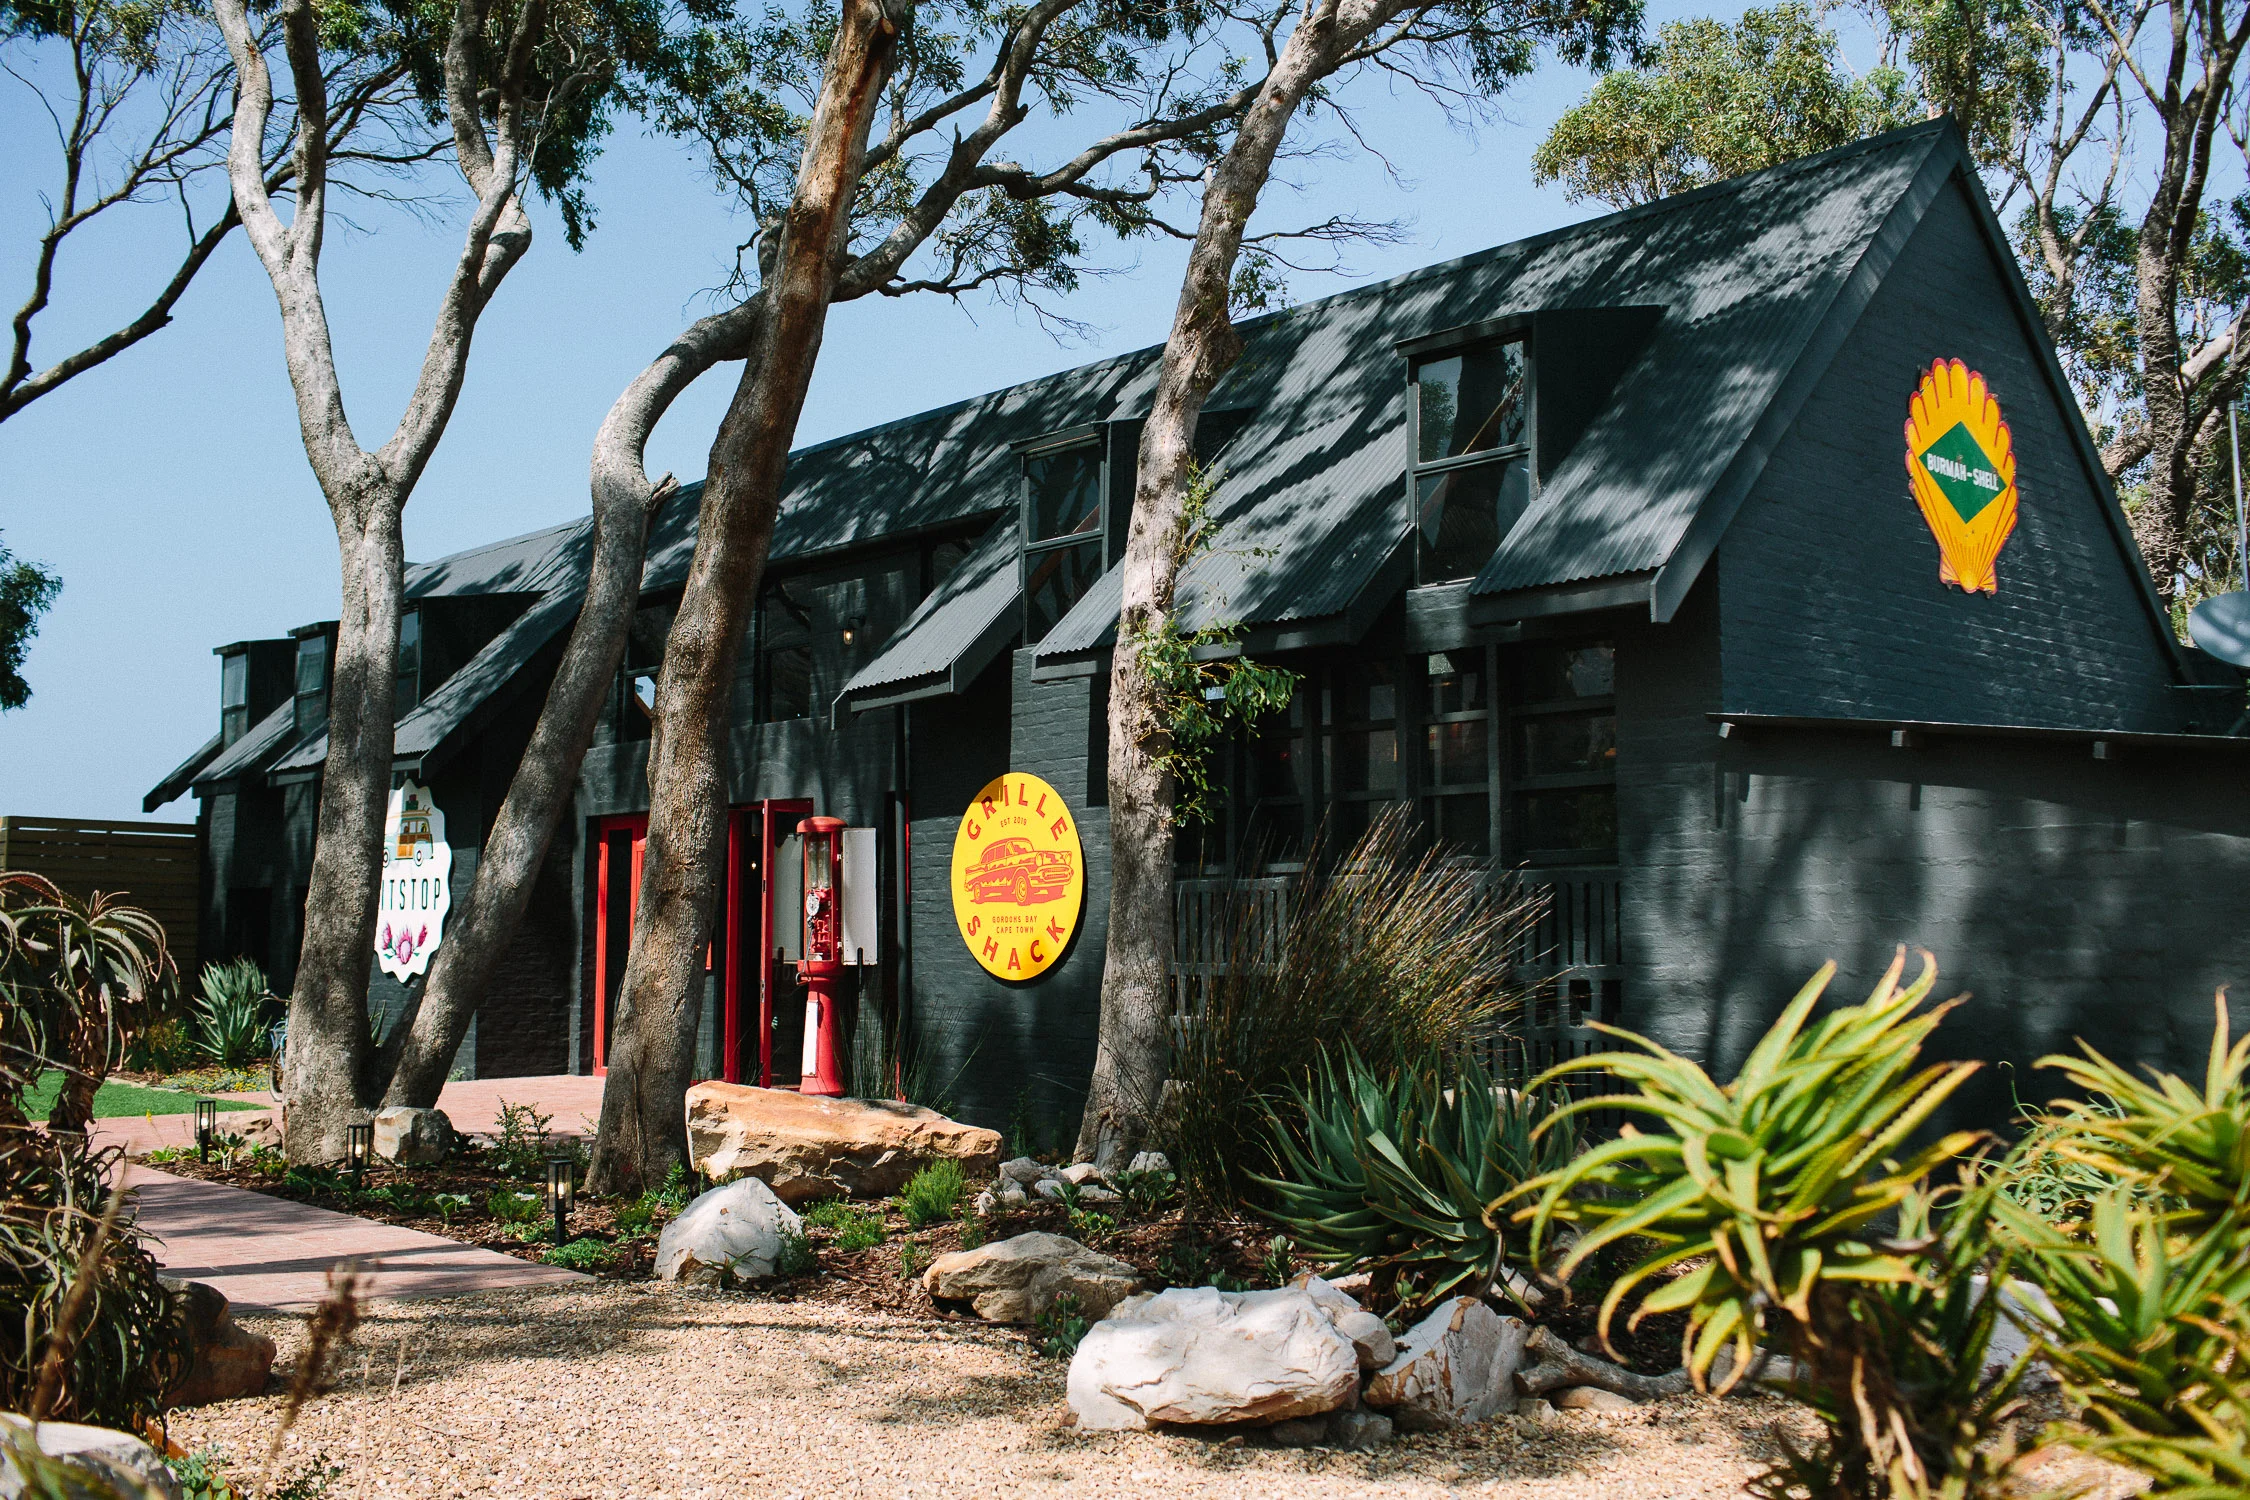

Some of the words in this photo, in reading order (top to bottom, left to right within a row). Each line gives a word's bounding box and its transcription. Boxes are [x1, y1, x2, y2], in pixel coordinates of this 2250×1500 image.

[1926, 453, 2000, 491] BURMAH-SHELL
[967, 783, 1068, 842] GRILLE
[1000, 818, 1011, 828] EST
[1014, 816, 1027, 826] 2019
[380, 877, 441, 911] ITSTOP
[992, 916, 1021, 924] GORDONS
[1025, 915, 1037, 923] BAY
[996, 926, 1013, 934] CAPE
[1016, 926, 1034, 934] TOWN
[967, 915, 1065, 970] SHACK
